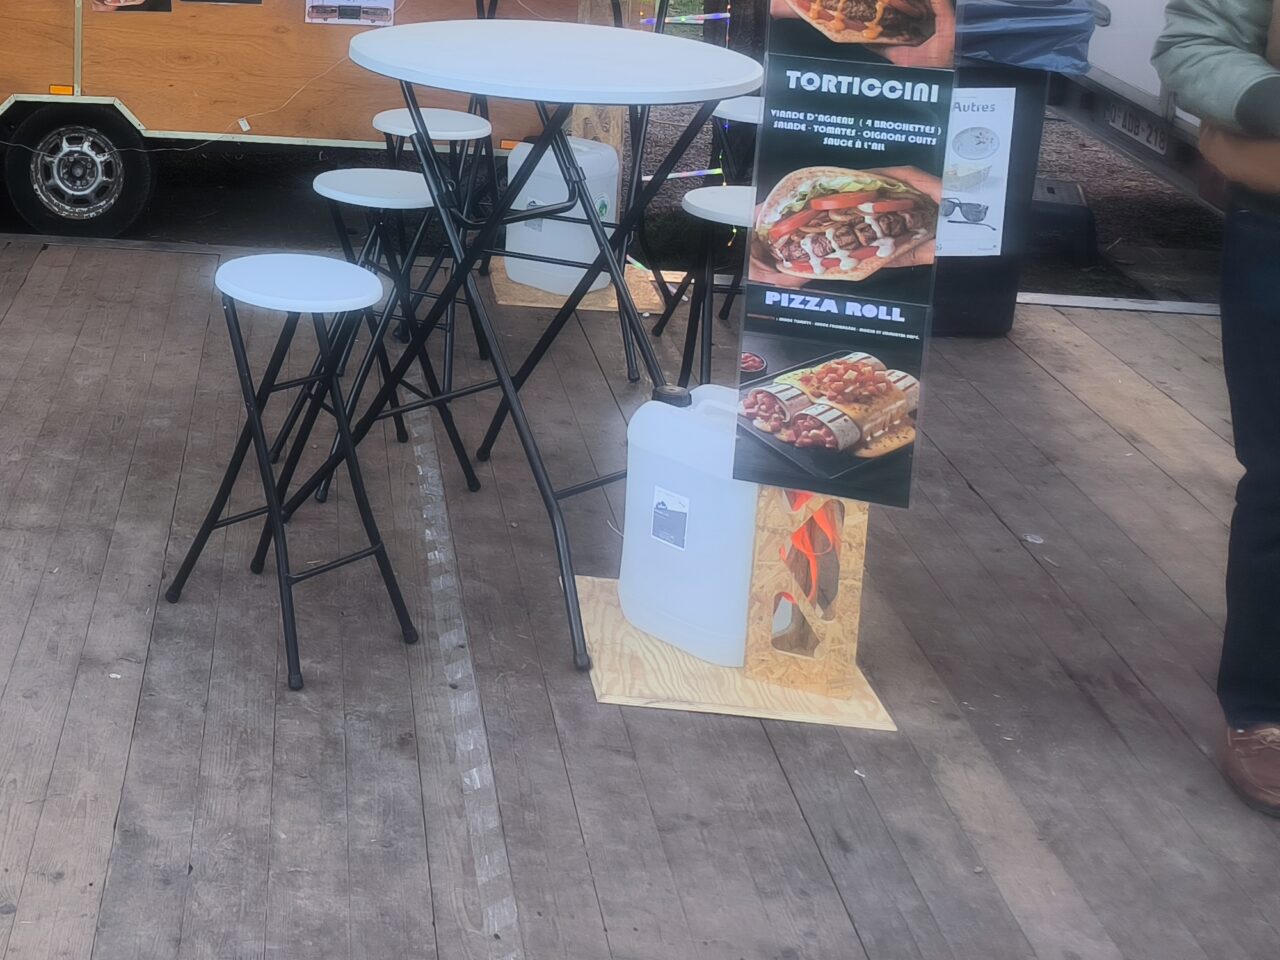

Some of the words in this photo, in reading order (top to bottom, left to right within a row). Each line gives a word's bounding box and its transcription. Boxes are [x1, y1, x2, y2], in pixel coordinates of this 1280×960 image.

[786, 70, 939, 103] TORTICCINI
[952, 102, 996, 112] Autres
[771, 110, 804, 120] VIANDE
[874, 120, 935, 134] BROCHETTES
[774, 121, 806, 131] SALADE
[813, 125, 856, 136] TOMATES
[863, 130, 906, 142] OIGNONS
[908, 135, 936, 145] CUITS
[823, 137, 853, 148] SAUCE
[765, 291, 839, 314] PIZZA
[845, 301, 905, 322] ROLL
